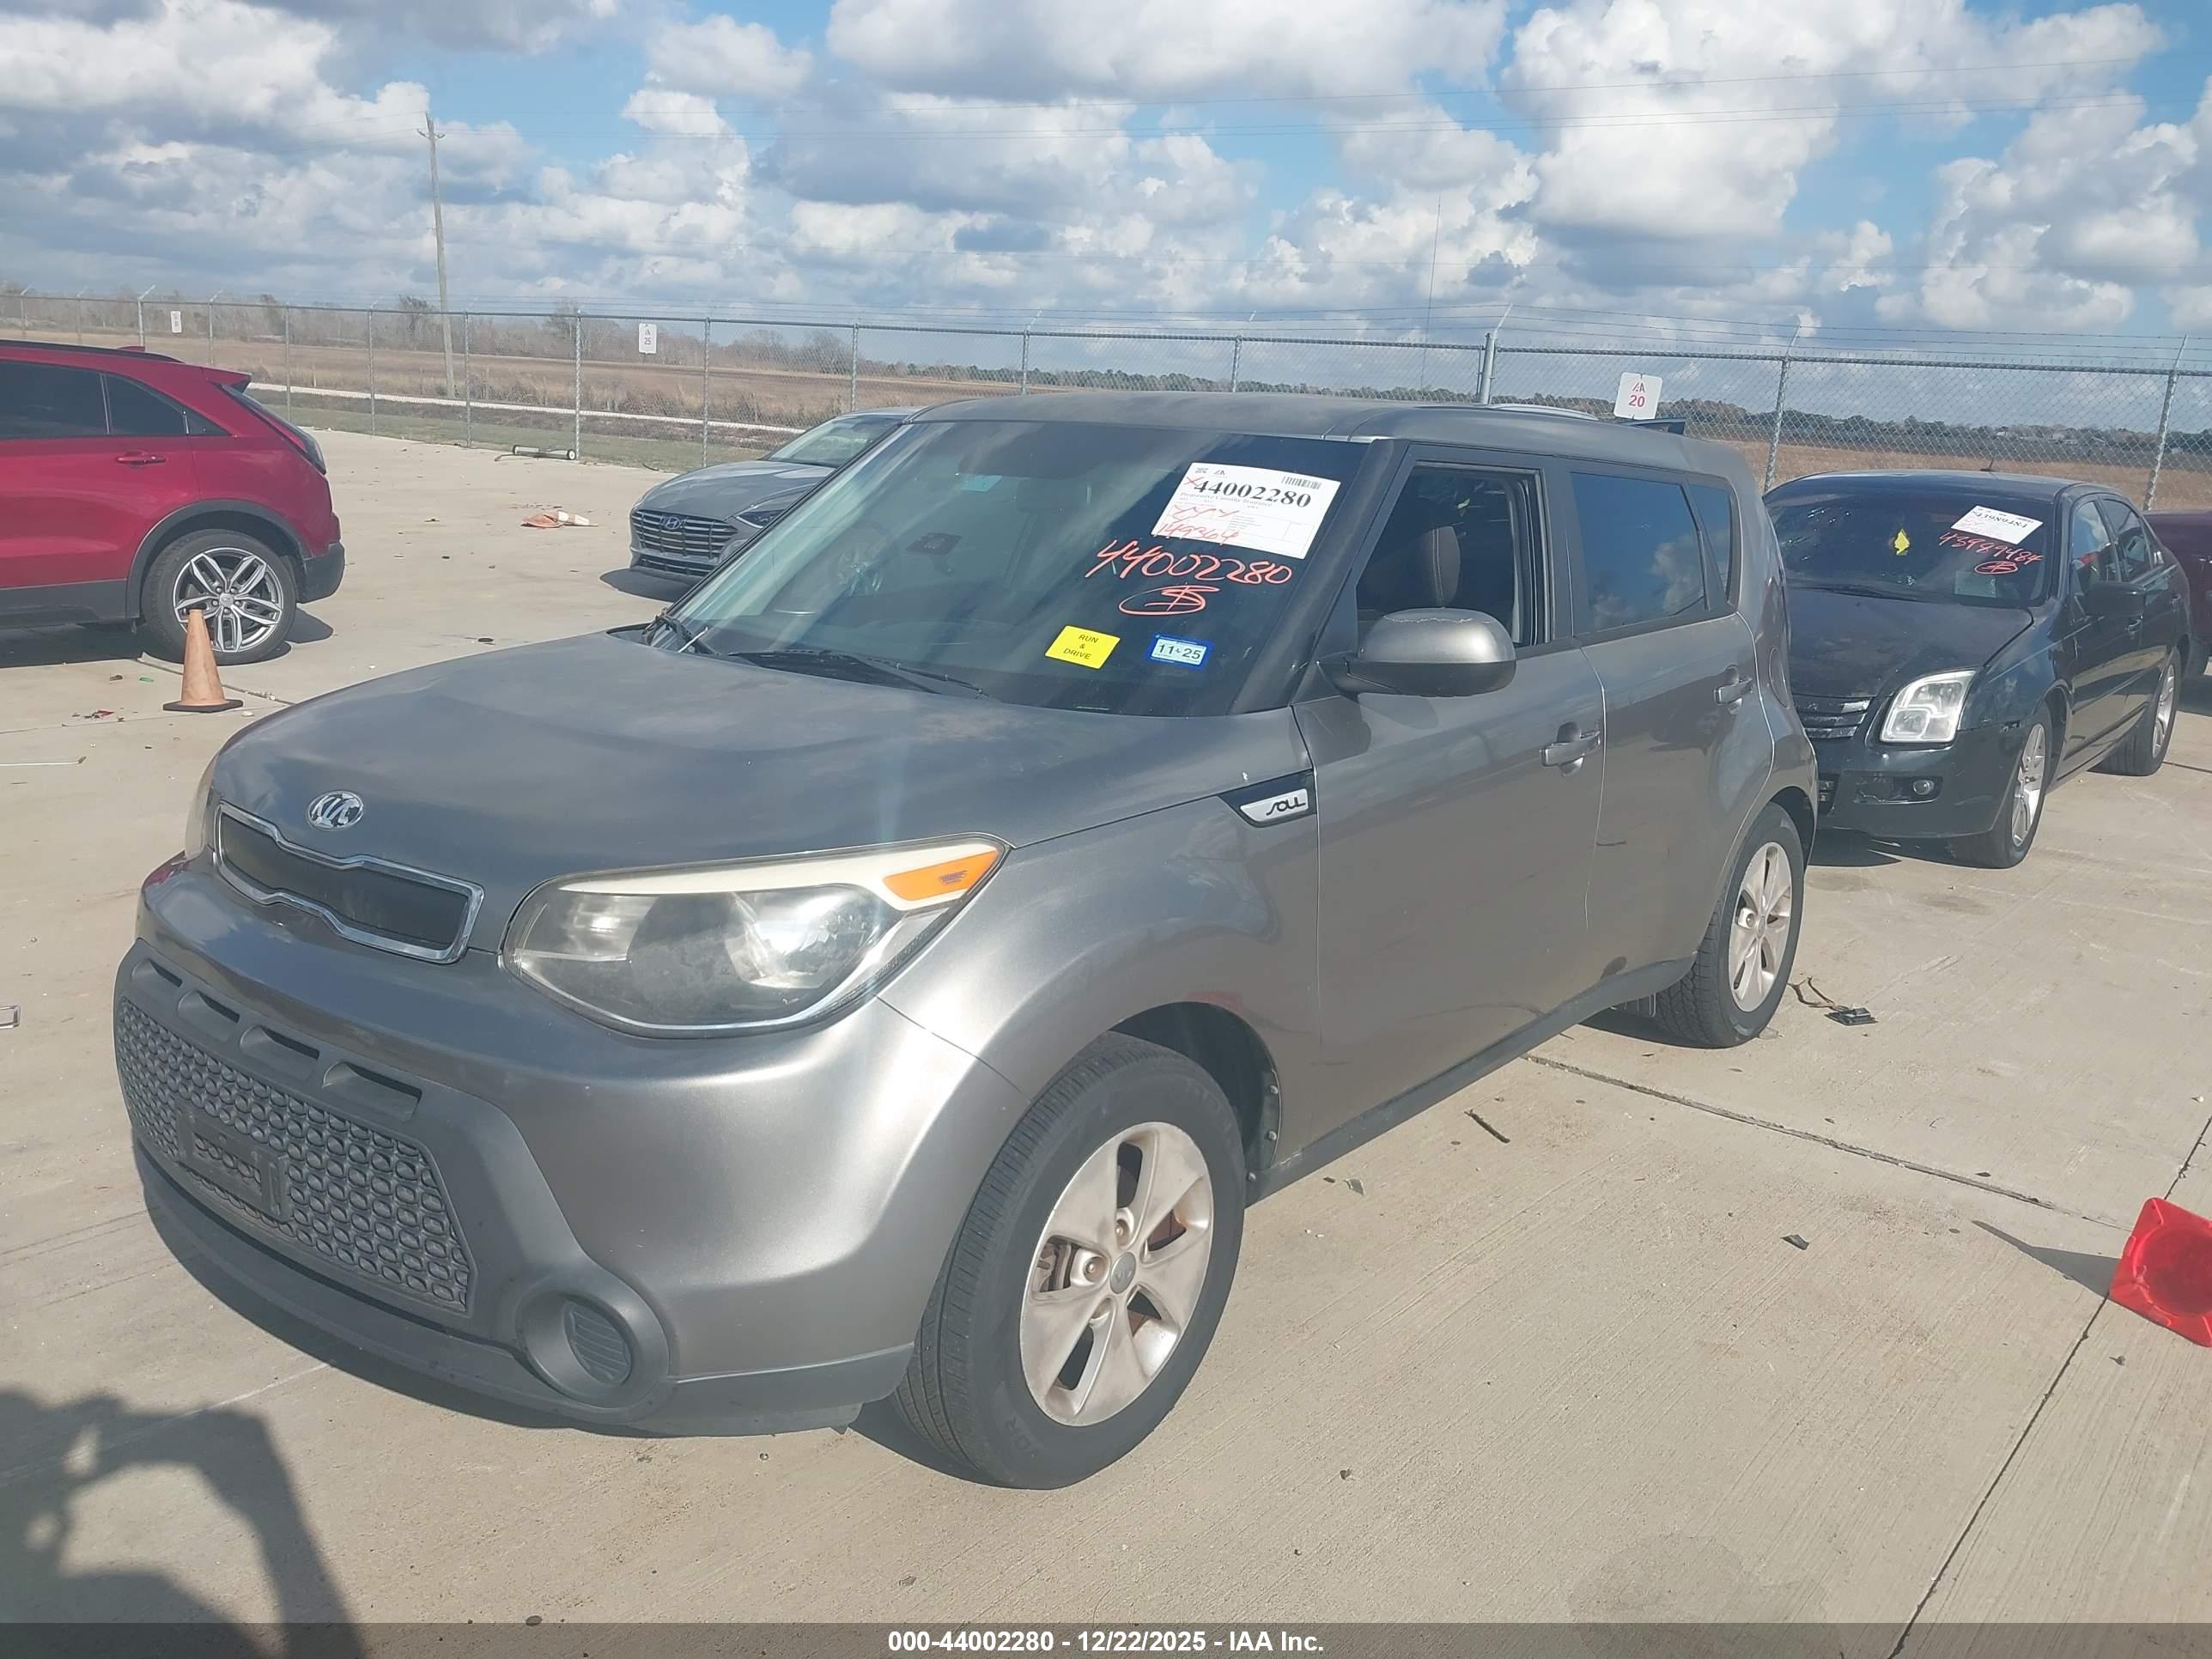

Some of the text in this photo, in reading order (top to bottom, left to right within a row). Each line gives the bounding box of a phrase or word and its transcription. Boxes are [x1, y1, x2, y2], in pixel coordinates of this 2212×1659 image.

[1628, 395, 1645, 408] 20
[1193, 480, 1312, 508] 44002280
[1085, 539, 1292, 584] 44002280
[1078, 634, 1099, 644] RUN
[1063, 648, 1092, 660] DRIVE
